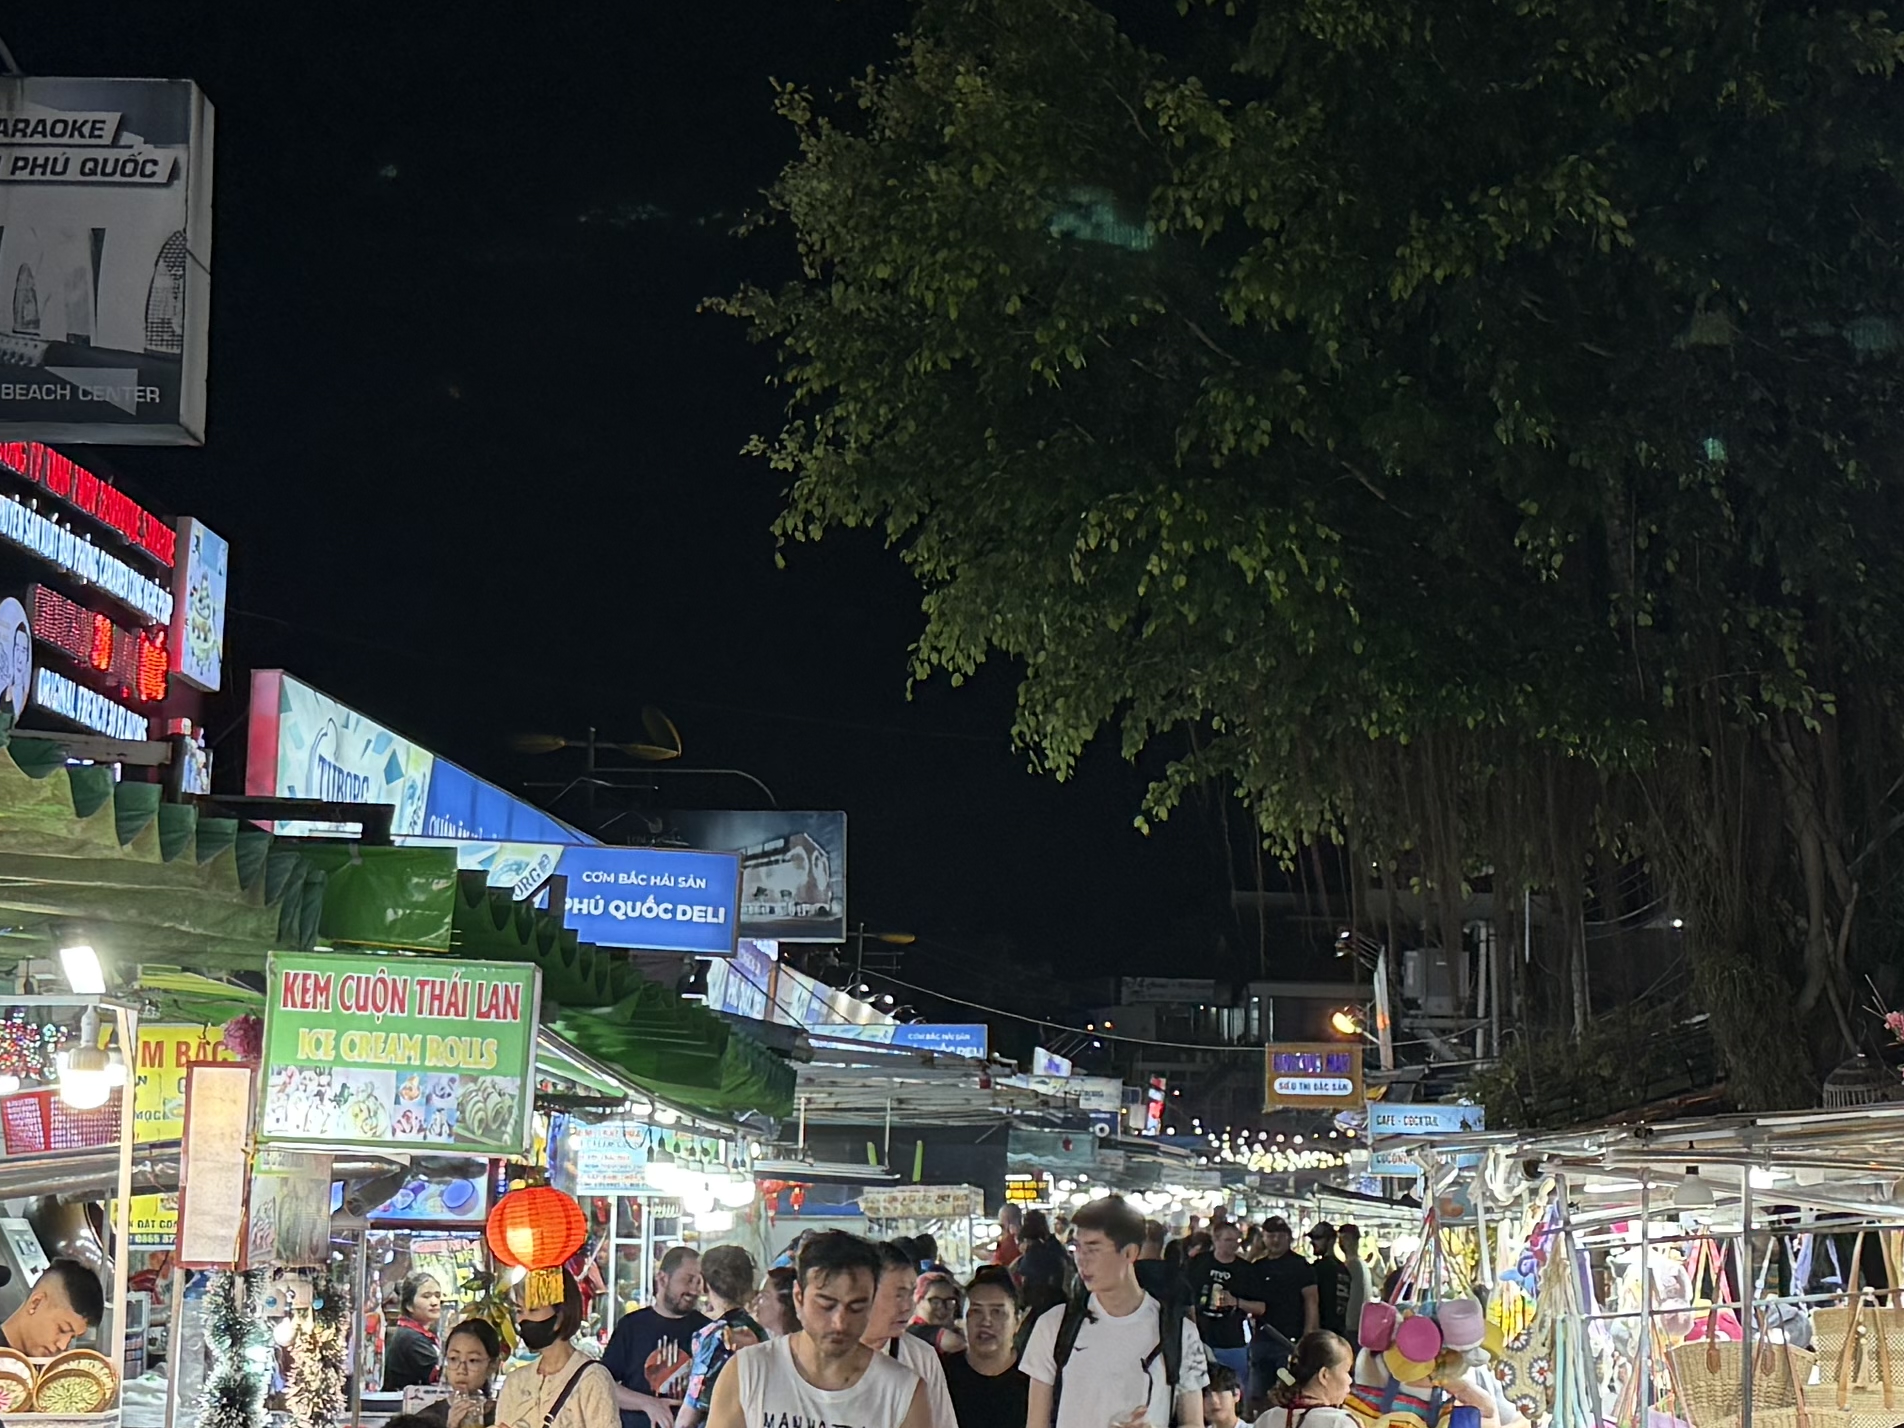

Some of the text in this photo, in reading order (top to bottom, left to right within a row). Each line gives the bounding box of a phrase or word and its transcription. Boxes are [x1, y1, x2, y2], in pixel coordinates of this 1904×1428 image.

[10, 150, 72, 178] PHÚ
[78, 150, 162, 180] QUỐC
[1, 384, 71, 402] BEACH
[78, 384, 161, 404] CENTER
[582, 870, 615, 884] CƠM
[677, 872, 707, 889] SẢN
[608, 893, 673, 921] QUỐC
[676, 903, 726, 924] DELI
[281, 968, 522, 1023] KEM CUỘN THÁI LAN
[298, 1028, 498, 1070] ICE CREAM ROLLS
